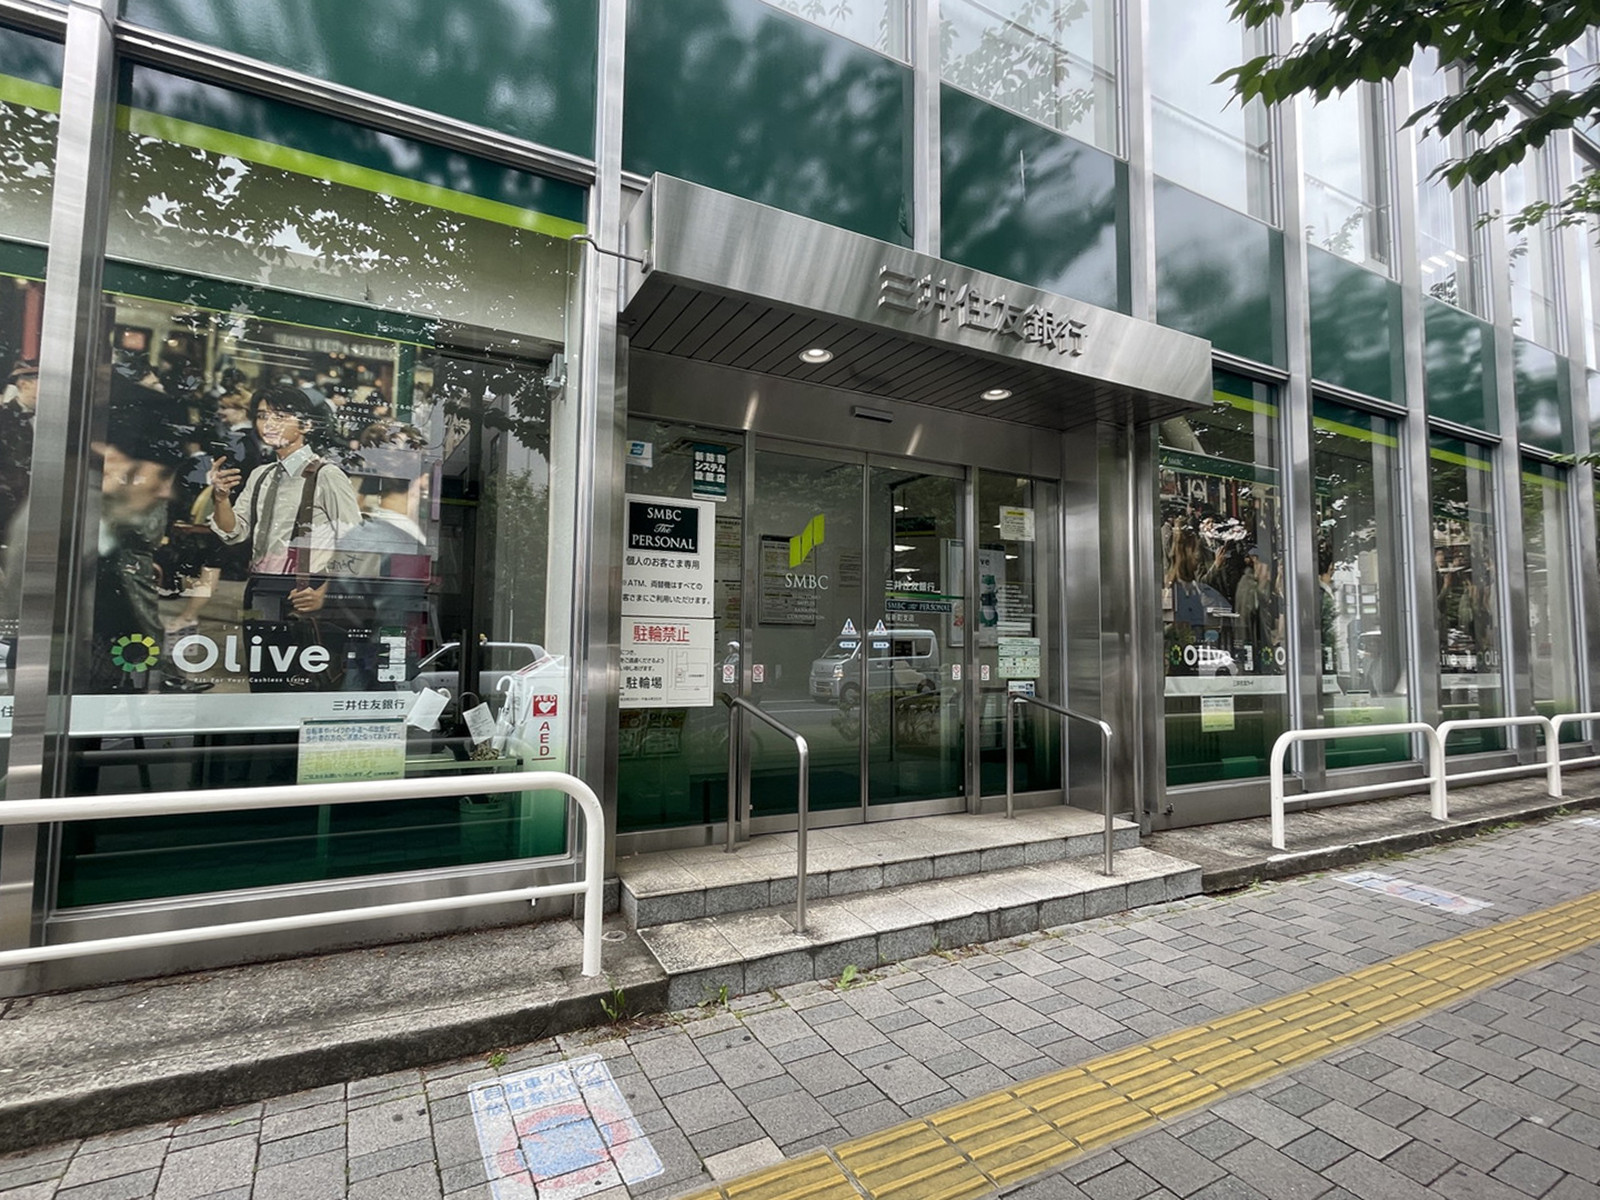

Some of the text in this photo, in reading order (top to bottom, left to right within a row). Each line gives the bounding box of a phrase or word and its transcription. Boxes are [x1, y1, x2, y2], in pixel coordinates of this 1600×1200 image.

[878, 264, 1087, 357] 三井住友銀行
[695, 461, 726, 474] システム
[647, 507, 682, 521] SMBC
[653, 523, 675, 534] The
[632, 534, 695, 550] PERSONAL
[626, 555, 700, 570] 個人のお客さま専用
[784, 573, 829, 590] SMBC
[633, 625, 690, 642] 駐輪禁止
[172, 634, 331, 673] Olive
[625, 676, 662, 689] 駐輪場
[332, 699, 406, 712] 三井住友銀行
[535, 694, 557, 702] AED
[539, 721, 551, 756] AED
